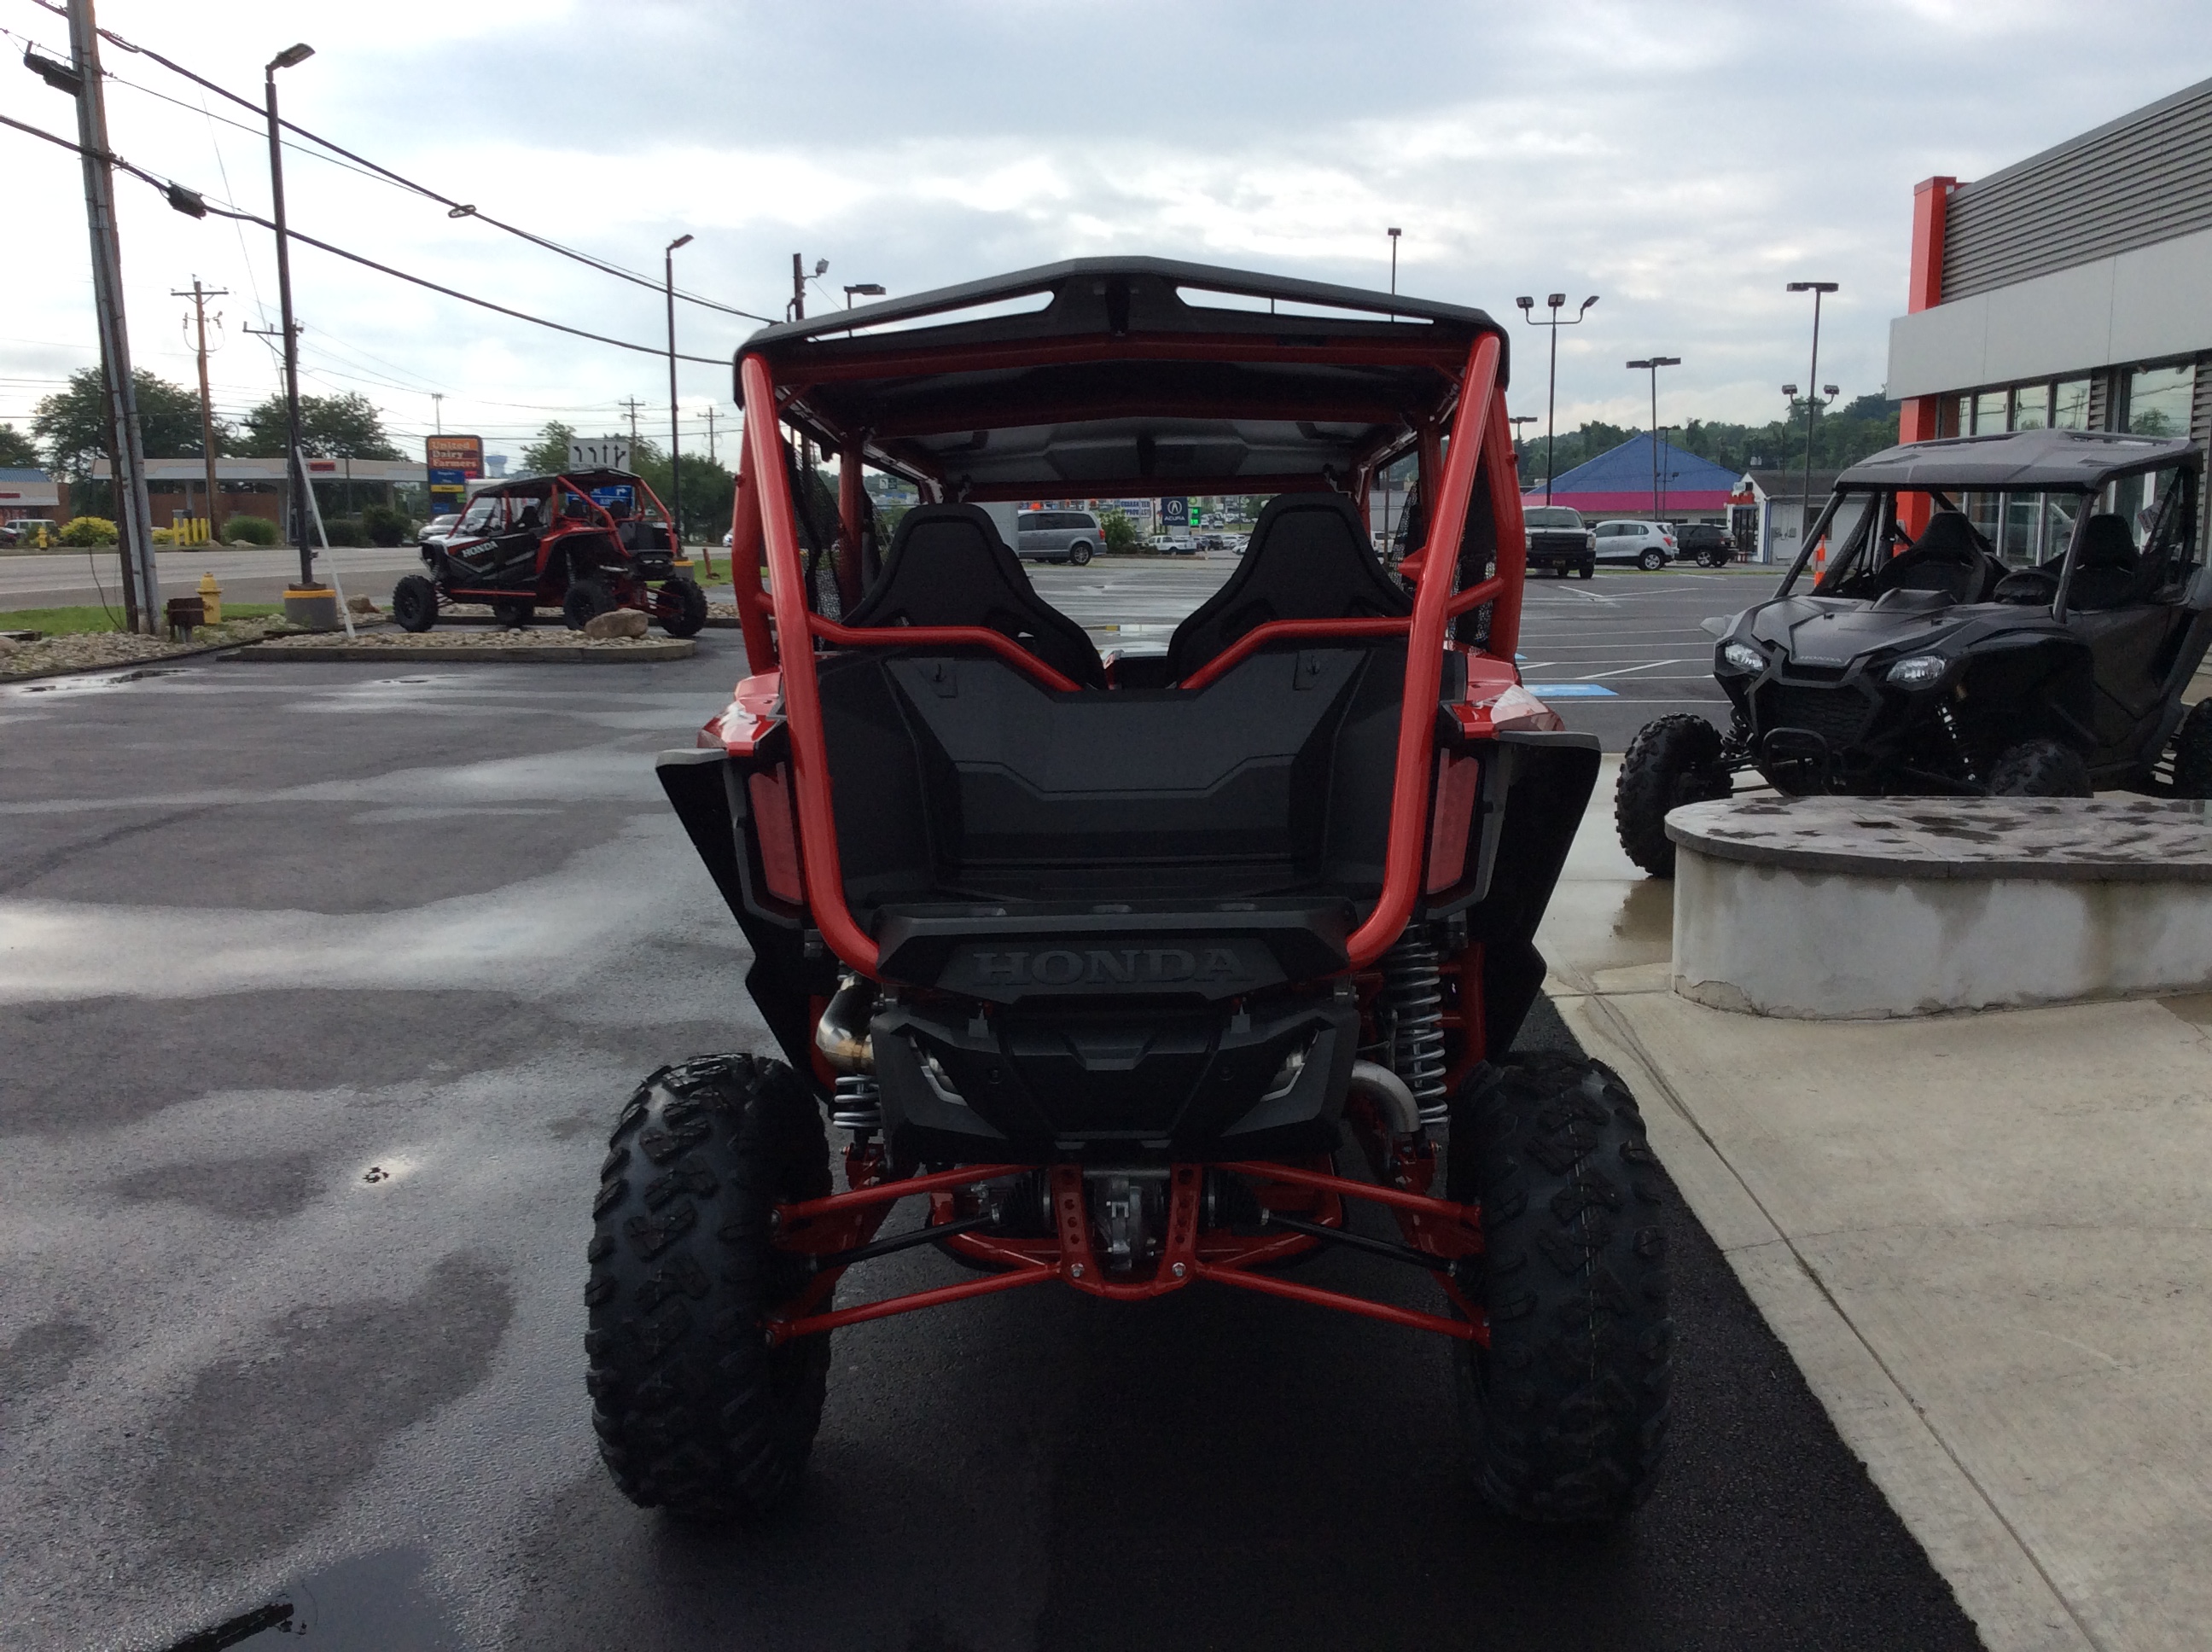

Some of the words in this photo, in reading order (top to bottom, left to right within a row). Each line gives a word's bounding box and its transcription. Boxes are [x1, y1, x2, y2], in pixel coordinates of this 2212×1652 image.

[432, 442, 469, 451] United
[433, 451, 463, 460] Dairy
[433, 458, 477, 468] Farmers
[462, 540, 498, 558] HONDA
[973, 948, 1256, 986] HONDA
